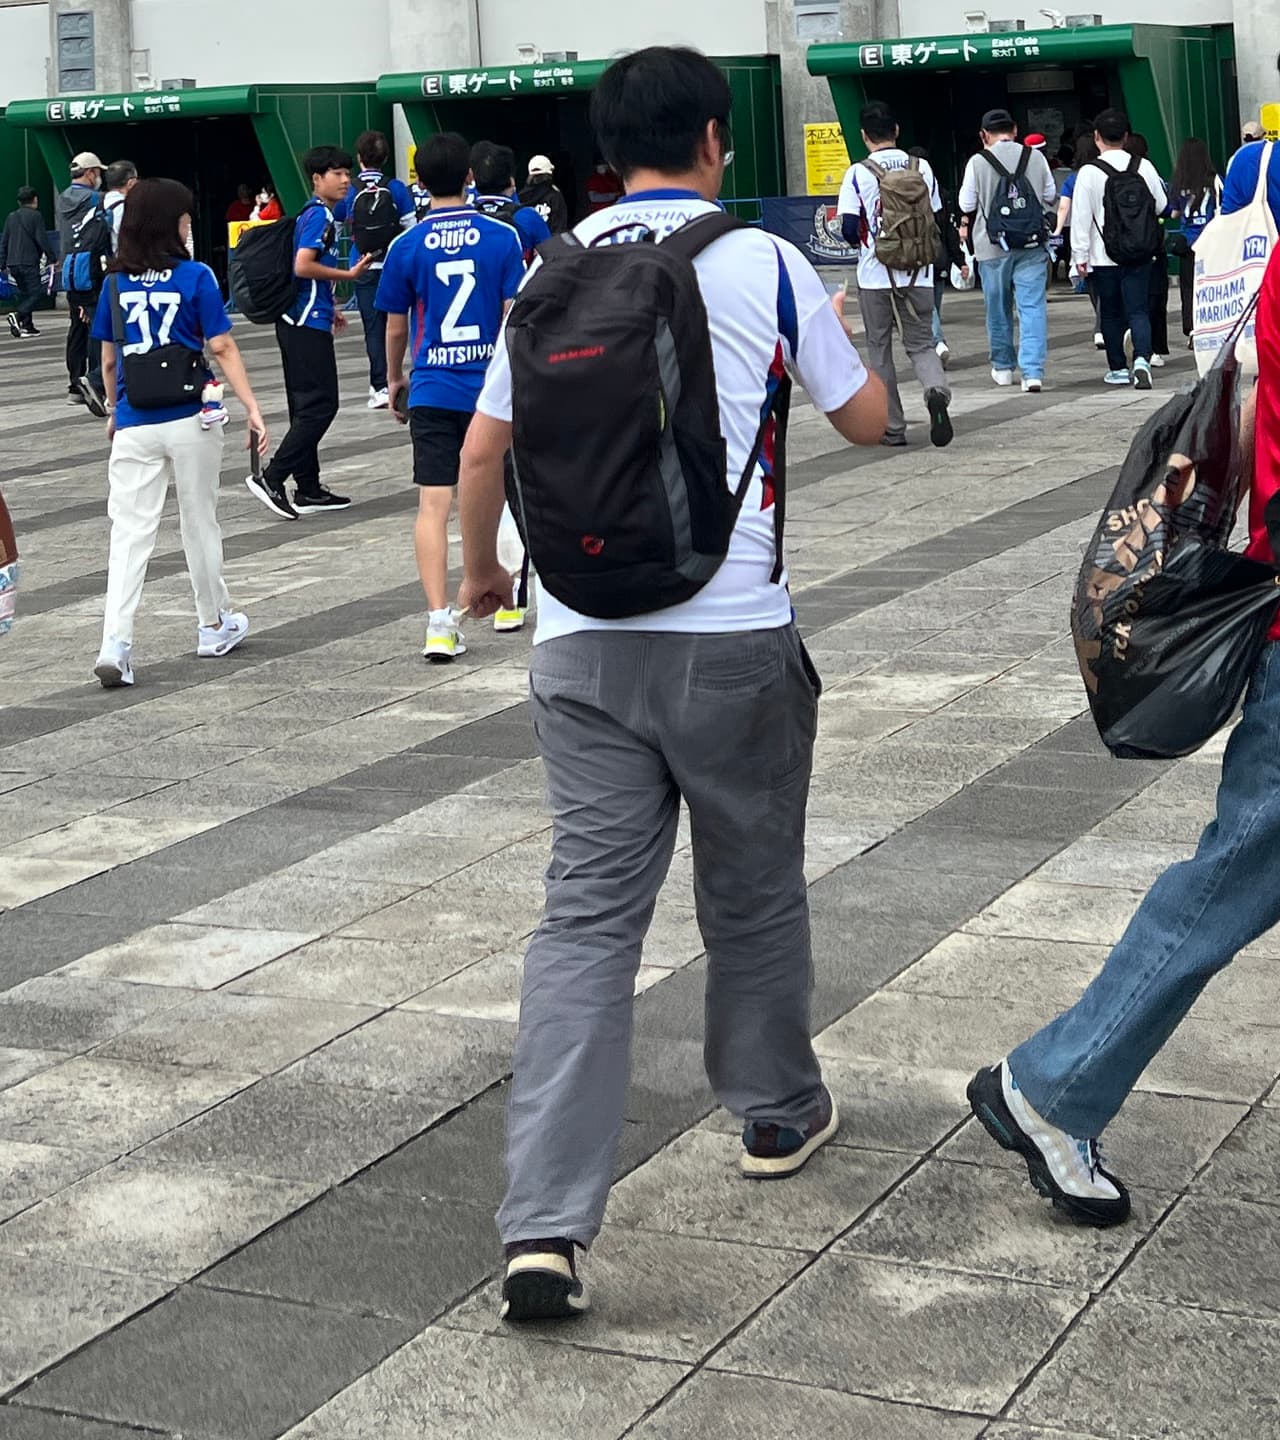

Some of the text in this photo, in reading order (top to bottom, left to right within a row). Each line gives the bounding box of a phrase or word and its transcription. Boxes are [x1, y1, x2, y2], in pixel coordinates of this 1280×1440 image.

[864, 39, 978, 66] E 東ゲート
[426, 70, 522, 95] E 東ゲート
[50, 104, 62, 119] E
[69, 97, 135, 120] 東ゲート
[431, 219, 472, 231] NISSHIN
[609, 211, 693, 224] NISSHIN
[1244, 238, 1266, 258] YFM
[435, 259, 480, 343] 2
[119, 291, 181, 357] 37
